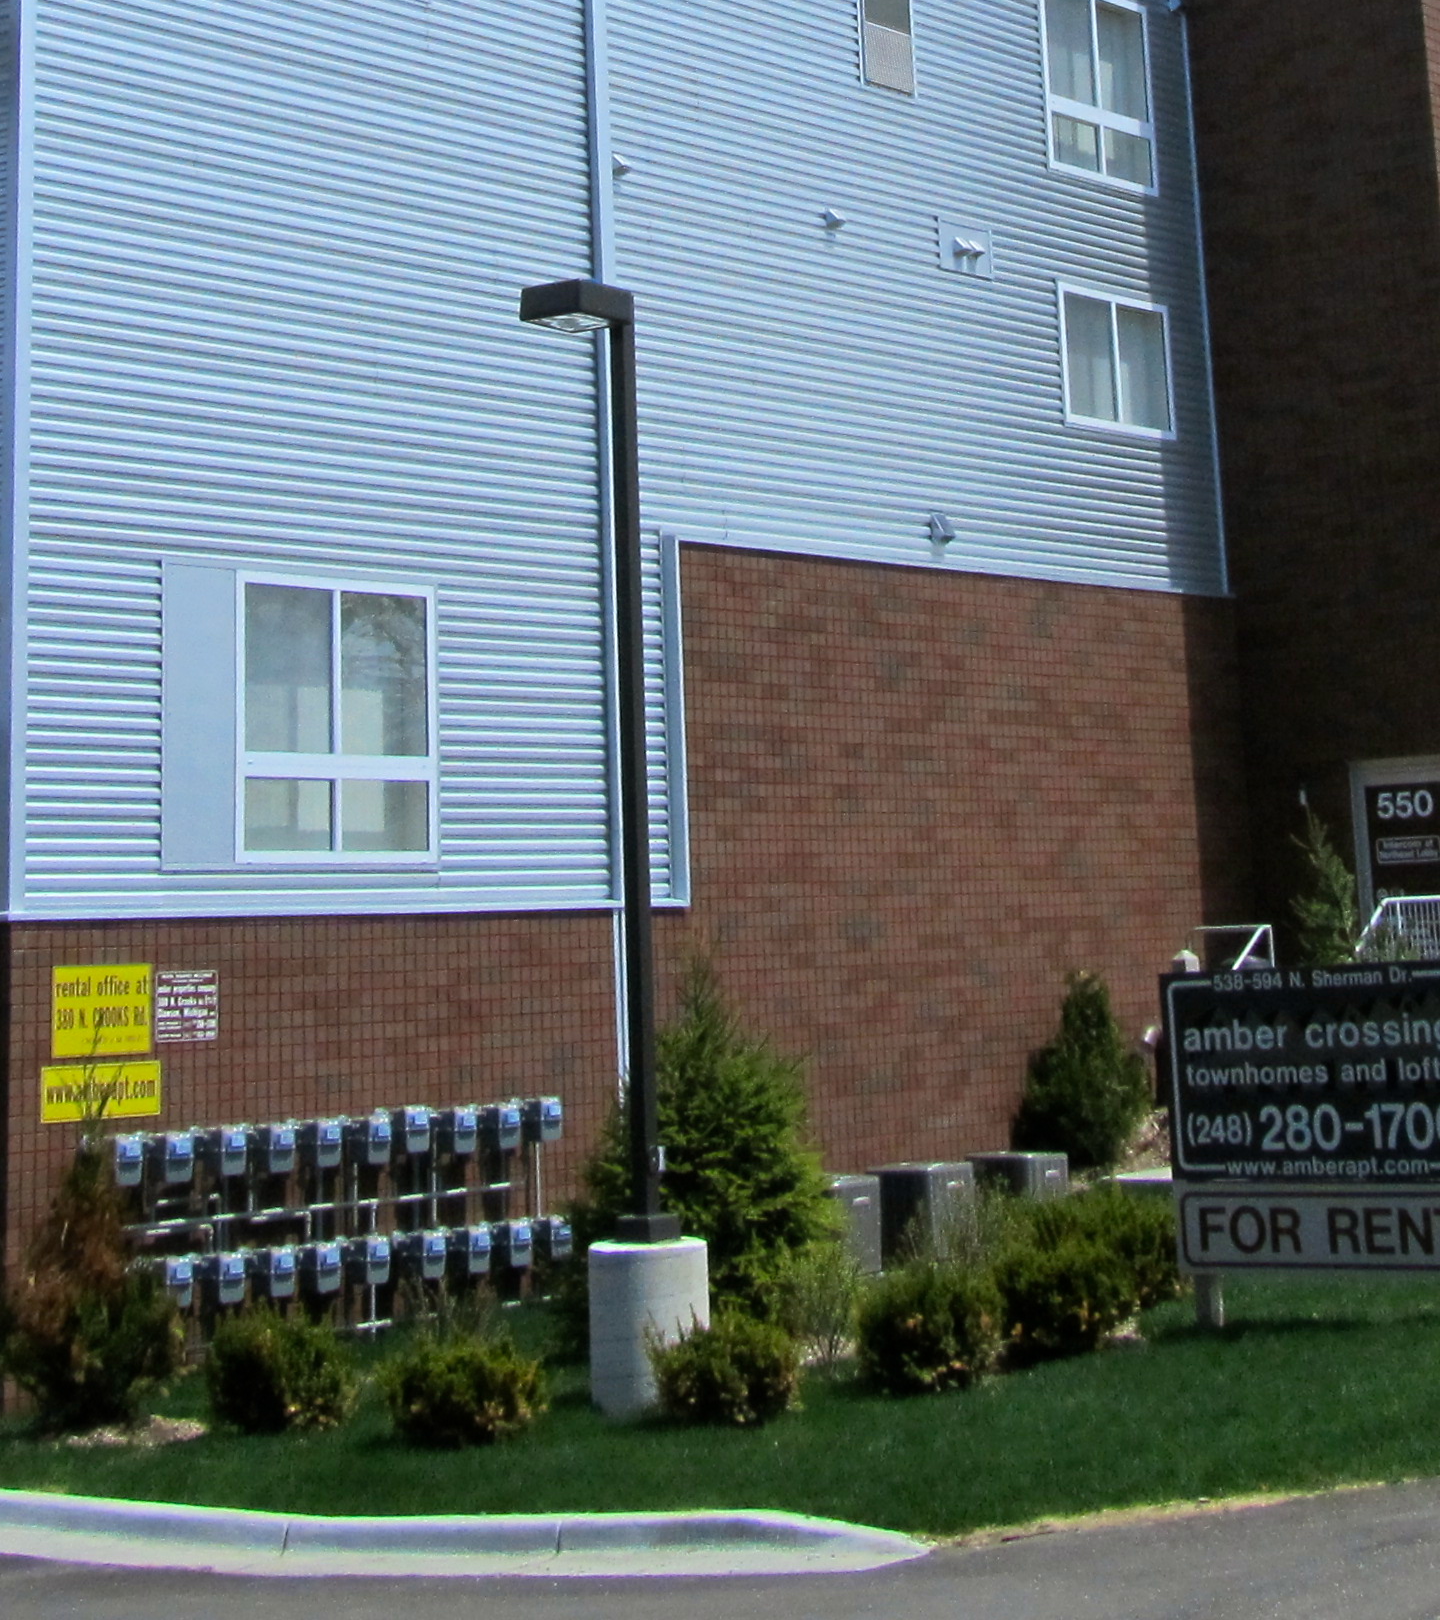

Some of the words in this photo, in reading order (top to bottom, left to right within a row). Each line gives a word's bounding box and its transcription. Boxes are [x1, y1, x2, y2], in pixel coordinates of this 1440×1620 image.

[1377, 789, 1434, 819] 550
[55, 975, 91, 998] rental
[97, 974, 130, 997] office
[136, 976, 148, 995] at
[1213, 972, 1282, 991] 538-594
[1289, 972, 1306, 987] N.
[1312, 969, 1383, 987] Sherman
[1389, 966, 1412, 983] Dr.
[1183, 1018, 1287, 1051] amber
[1186, 1062, 1329, 1086] townhomes
[1341, 1058, 1387, 1082] and
[1187, 1111, 1253, 1147] (248)
[1225, 1156, 1430, 1179] www.amberapt.com
[1198, 1205, 1302, 1254] FOR
